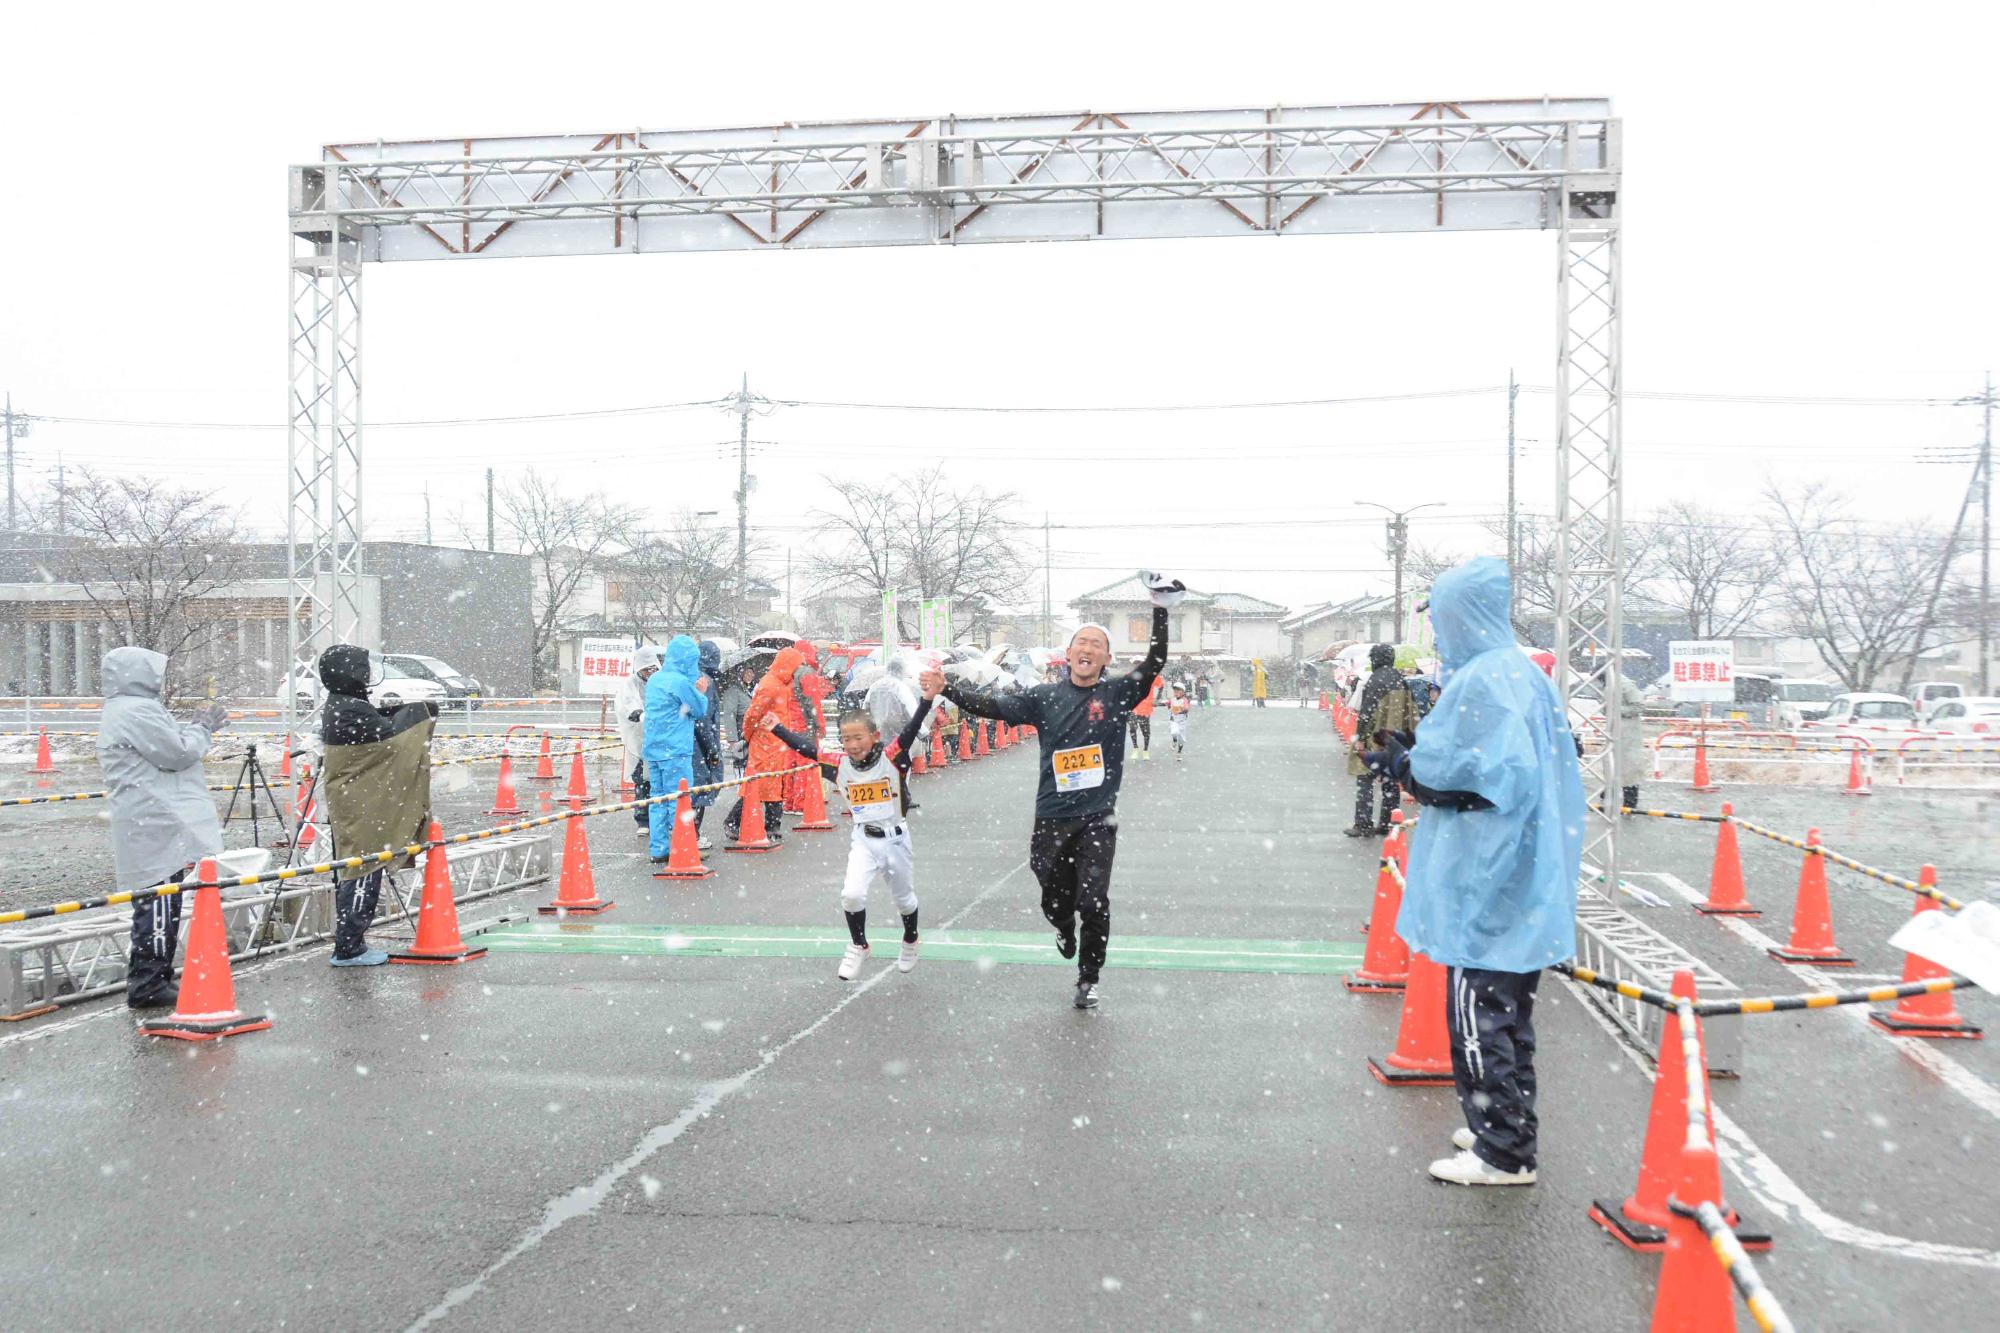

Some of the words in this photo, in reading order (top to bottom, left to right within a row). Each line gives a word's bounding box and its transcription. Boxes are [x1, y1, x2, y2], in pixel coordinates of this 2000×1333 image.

[583, 657, 631, 677] 駐車禁止
[1673, 662, 1730, 682] 駐車禁止
[1062, 753, 1086, 770] 222
[852, 787, 875, 803] 222
